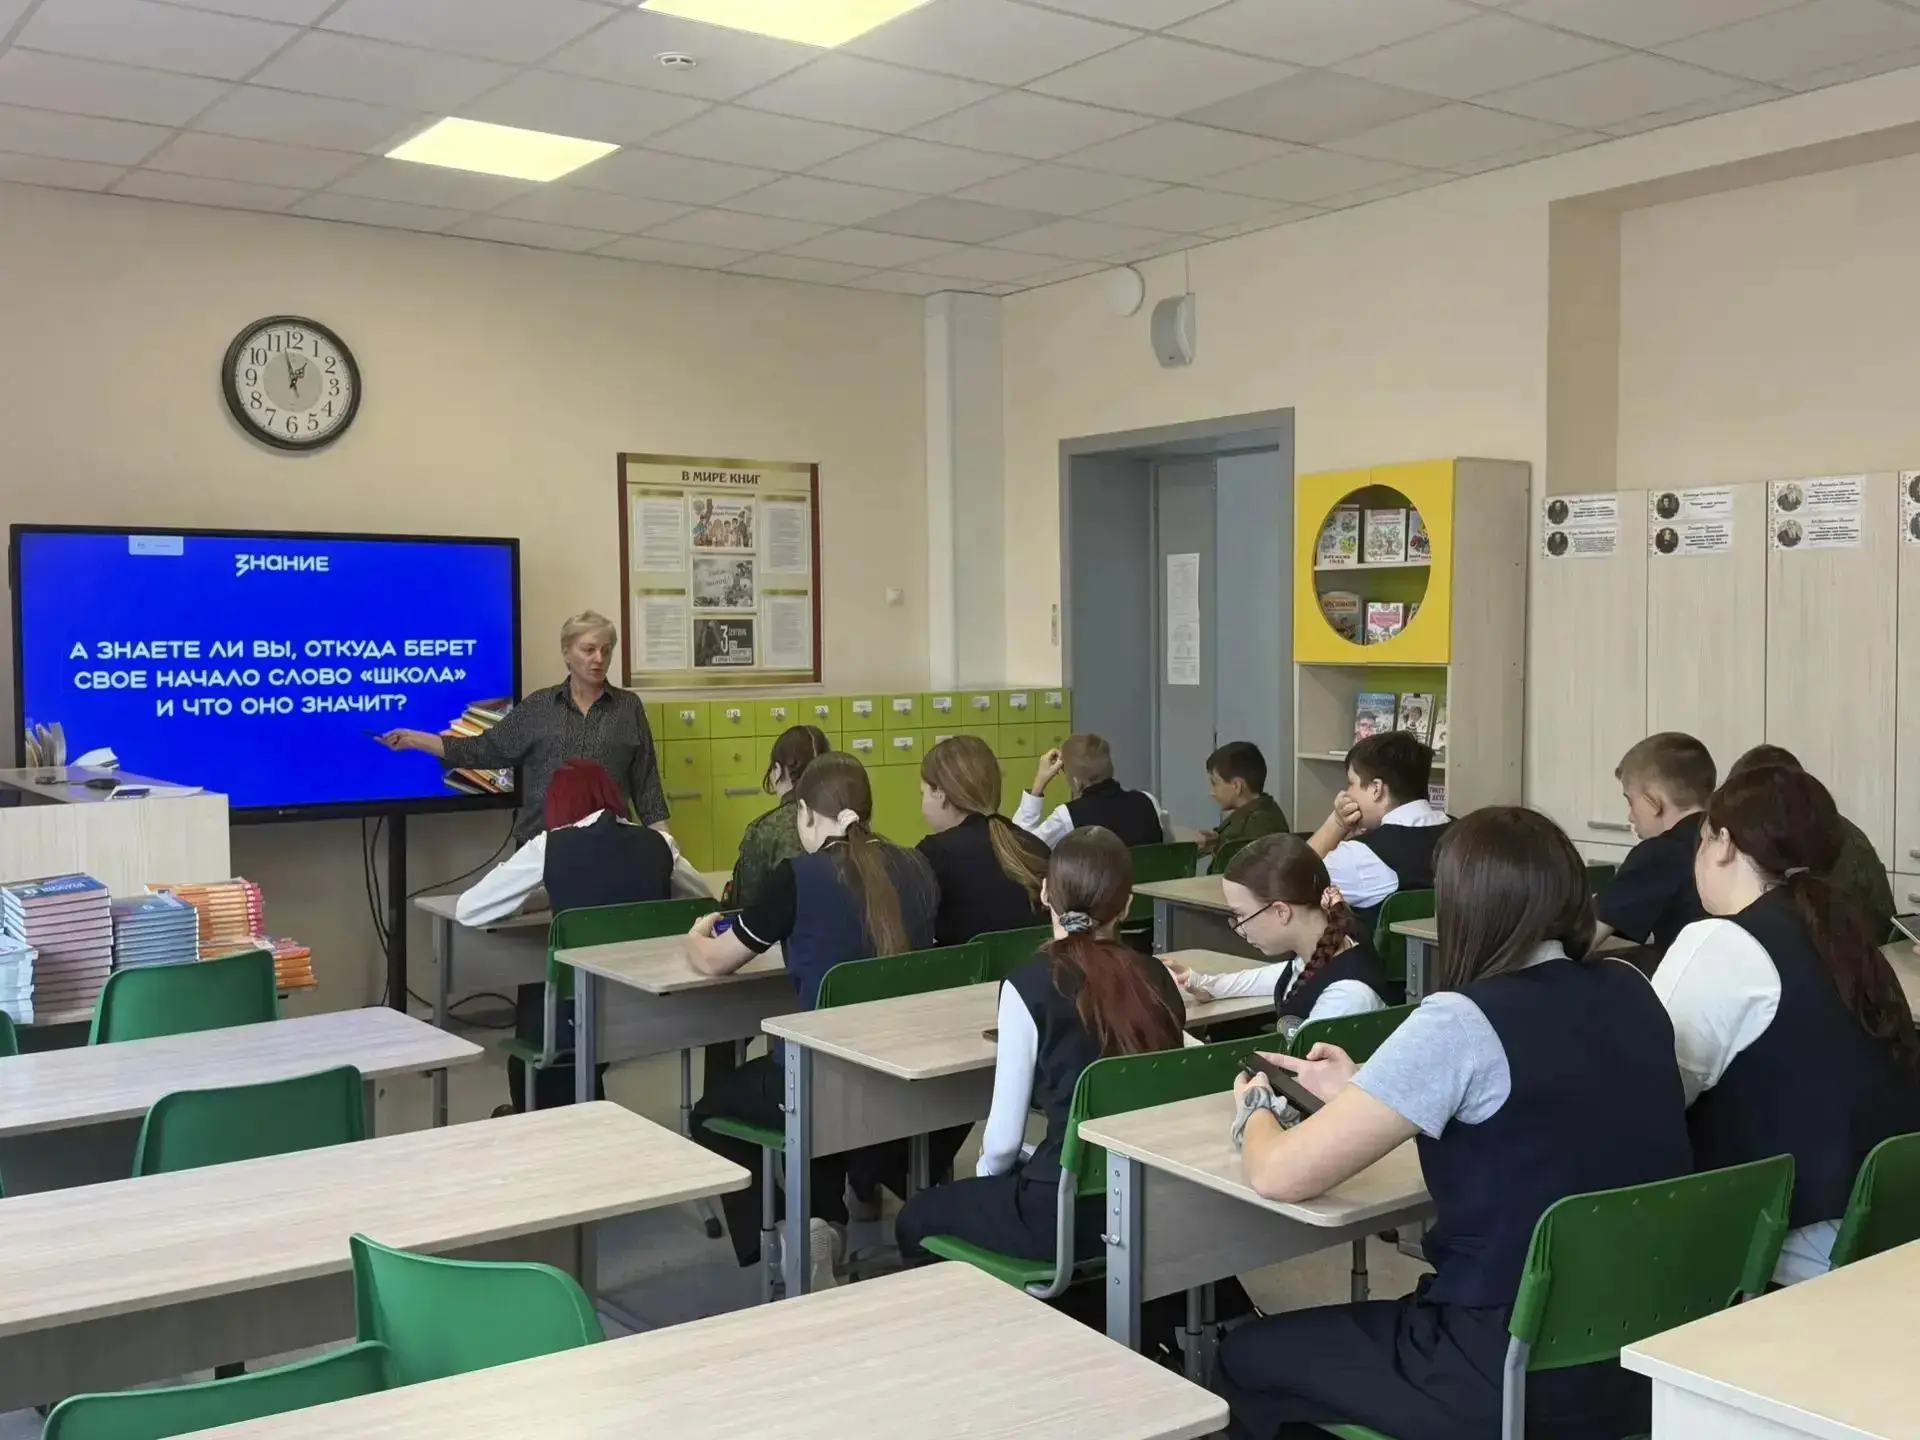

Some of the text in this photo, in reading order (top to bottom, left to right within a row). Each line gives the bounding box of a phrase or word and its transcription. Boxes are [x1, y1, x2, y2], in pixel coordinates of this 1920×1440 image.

[267, 333, 281, 352] 11
[285, 331, 304, 350] 12
[312, 340, 320, 357] 1
[250, 347, 267, 366] 10
[324, 356, 336, 374] 2
[245, 368, 257, 387] 9
[328, 378, 340, 397] 3
[250, 391, 262, 409] 8
[321, 400, 334, 418] 4
[265, 408, 276, 426] 7
[286, 415, 298, 433] 6
[307, 413, 319, 431] 5
[681, 470, 761, 485] В МИРЕ КНИГ
[69, 639, 477, 660] А ЗНАЕТЕ ЛИ ВЫ, ОТКУДА БЕРЕТ
[73, 666, 467, 690] СВОЕ НАЧАЛО СЛОВО «ШКОЛА»
[156, 693, 408, 717] И ЧТО ОНО ЗНАЧИТ?
